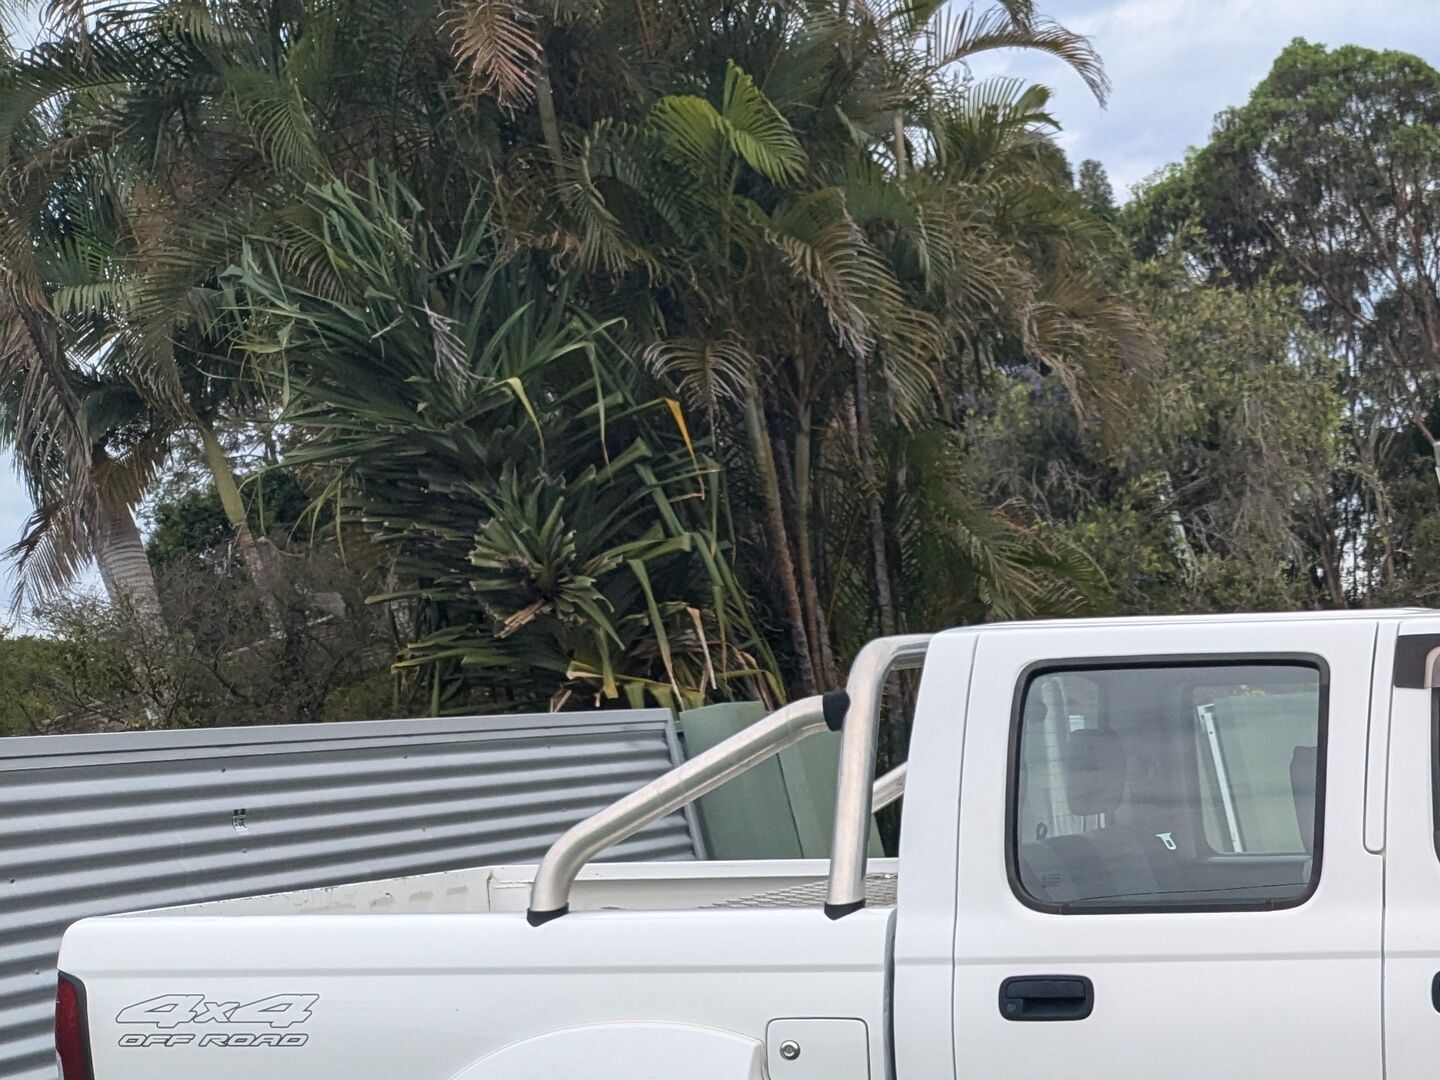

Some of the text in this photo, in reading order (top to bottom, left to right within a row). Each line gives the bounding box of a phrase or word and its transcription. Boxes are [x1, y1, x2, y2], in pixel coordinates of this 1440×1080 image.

[115, 993, 321, 1029] 4x4
[117, 1033, 310, 1048] OFF ROAD
